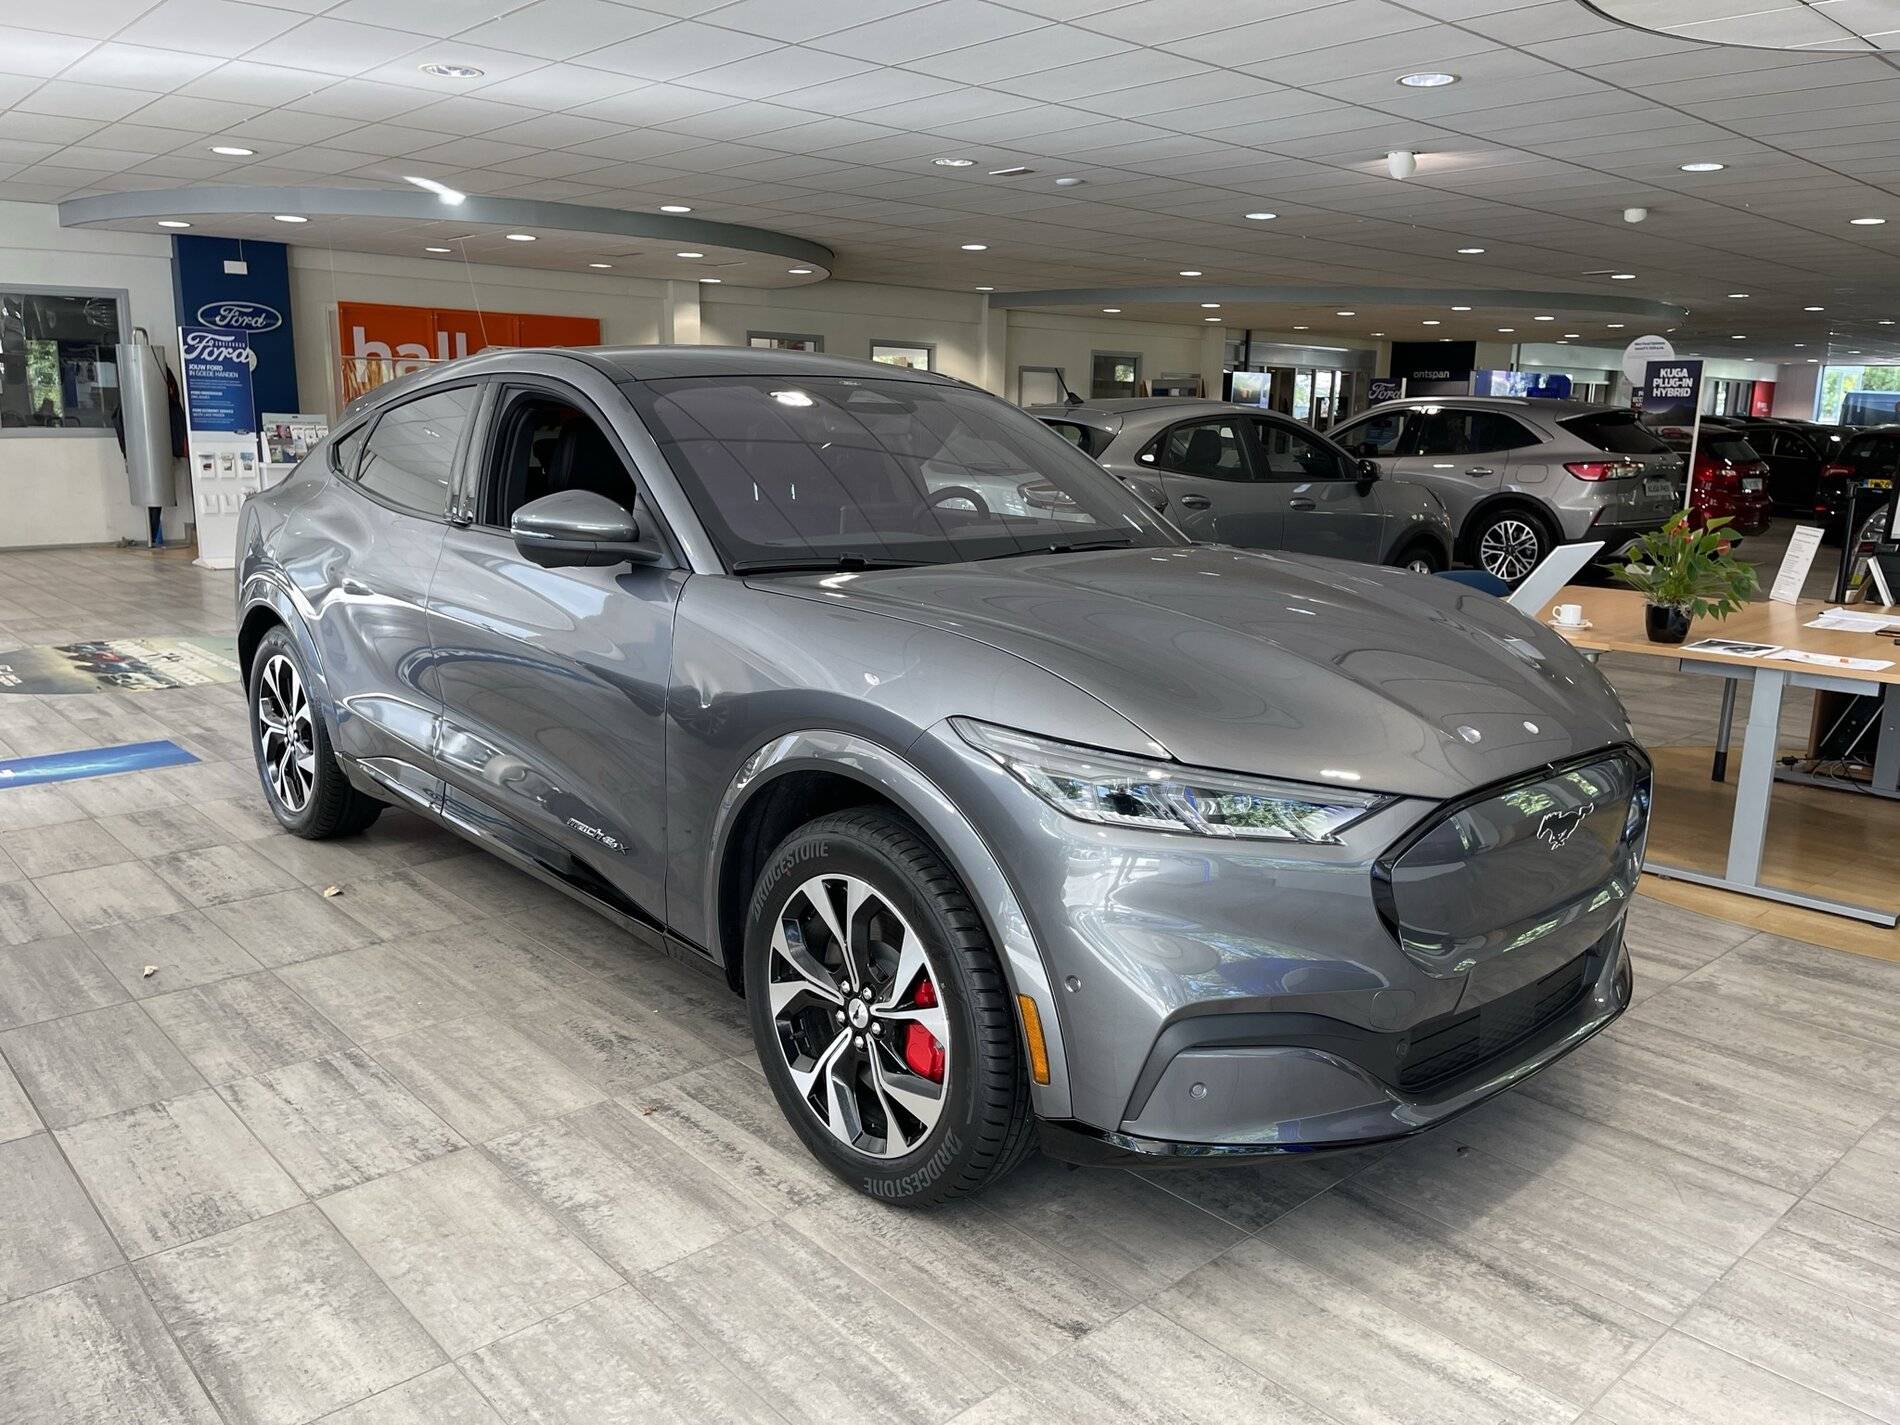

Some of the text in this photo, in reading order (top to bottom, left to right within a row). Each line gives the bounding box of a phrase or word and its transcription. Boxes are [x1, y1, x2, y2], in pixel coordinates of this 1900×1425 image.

[215, 305, 266, 328] Ford
[207, 364, 223, 372] FORD
[1660, 368, 1688, 378] KUGA
[1413, 370, 1450, 379] ontspan
[1653, 378, 1693, 388] PLUG-IN
[1652, 387, 1691, 397] HYBRID
[750, 840, 829, 922] BRIDGESTONE
[863, 1125, 963, 1198] BRIDGESTONE
